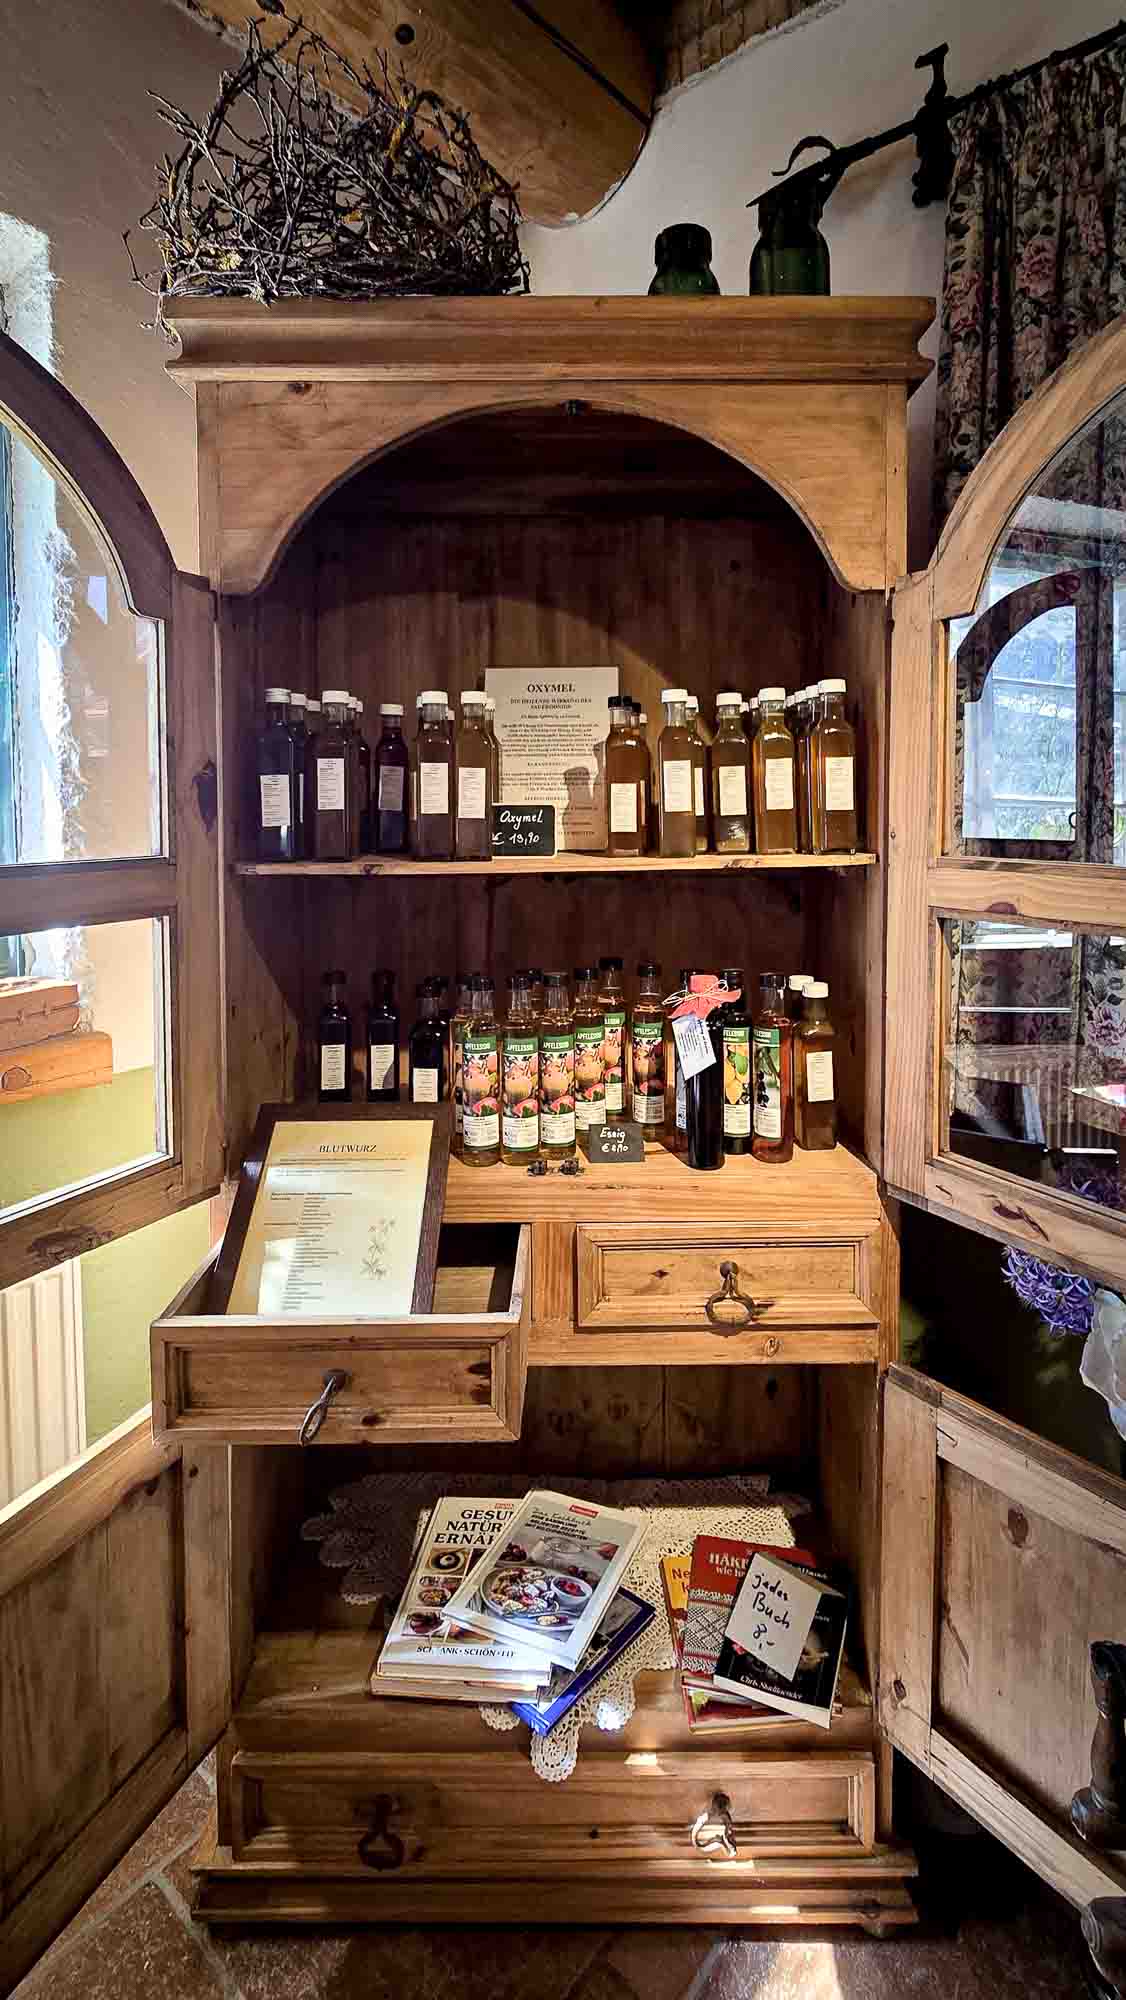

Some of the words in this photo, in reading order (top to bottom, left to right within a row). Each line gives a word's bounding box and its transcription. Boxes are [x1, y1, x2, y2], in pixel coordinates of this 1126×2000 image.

[527, 683, 576, 693] OXYMEL
[600, 1127, 625, 1143] Essig
[319, 1144, 377, 1153] BLUTWURZ
[446, 1520, 504, 1533] NATÜR
[752, 1591, 790, 1629] Buch
